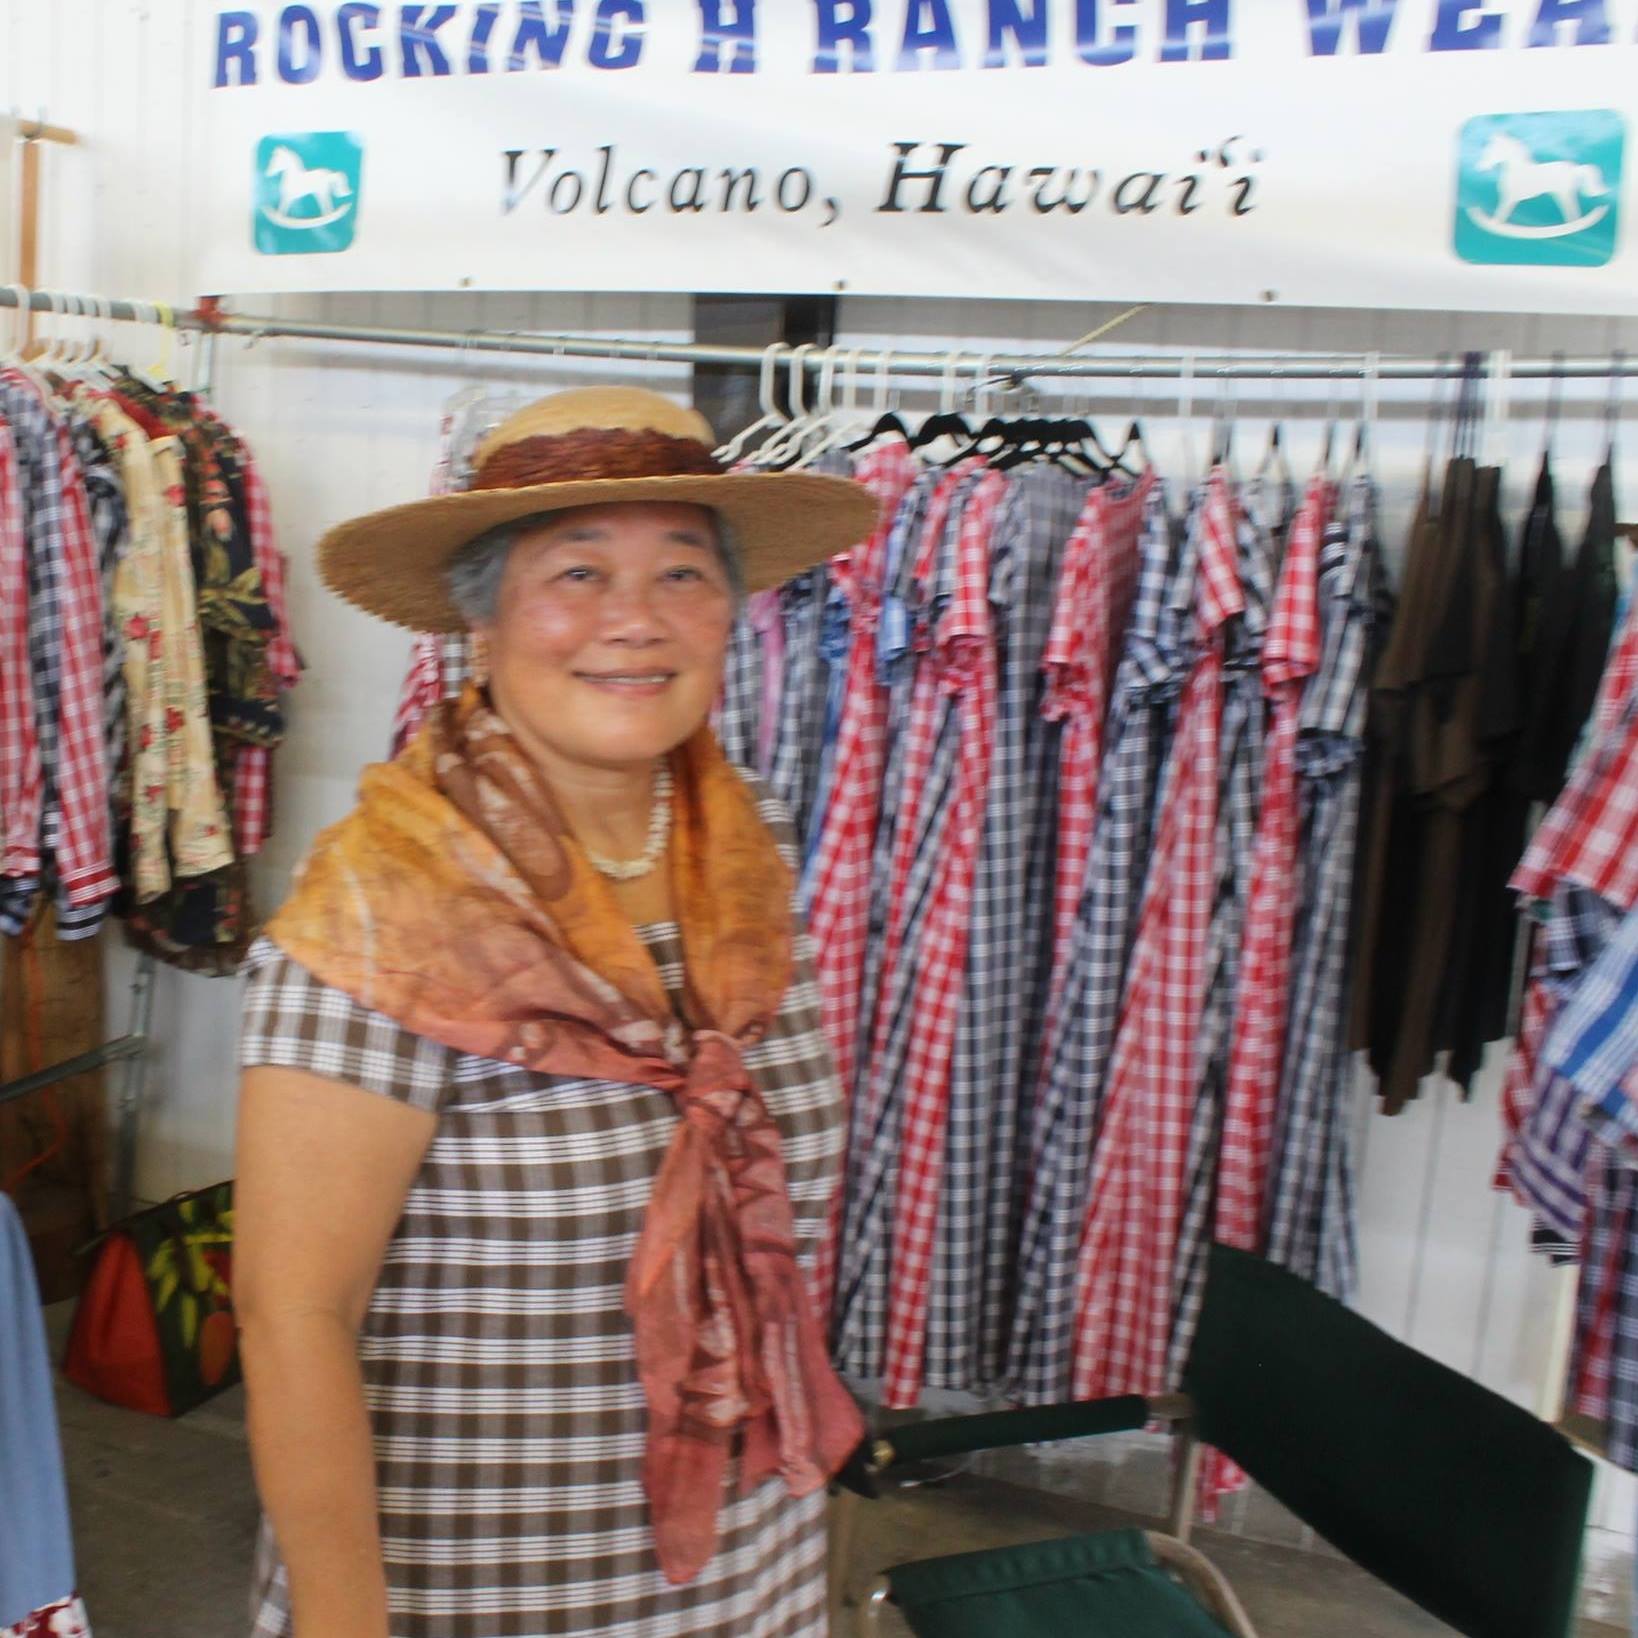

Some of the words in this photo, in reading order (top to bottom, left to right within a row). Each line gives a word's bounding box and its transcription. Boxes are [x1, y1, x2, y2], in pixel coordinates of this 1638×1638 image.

[212, 0, 647, 88] ROCKING
[691, 0, 758, 73] H
[810, 0, 1233, 74] RANCH
[1308, 0, 1638, 56] WEA
[499, 144, 840, 227] Volcano,
